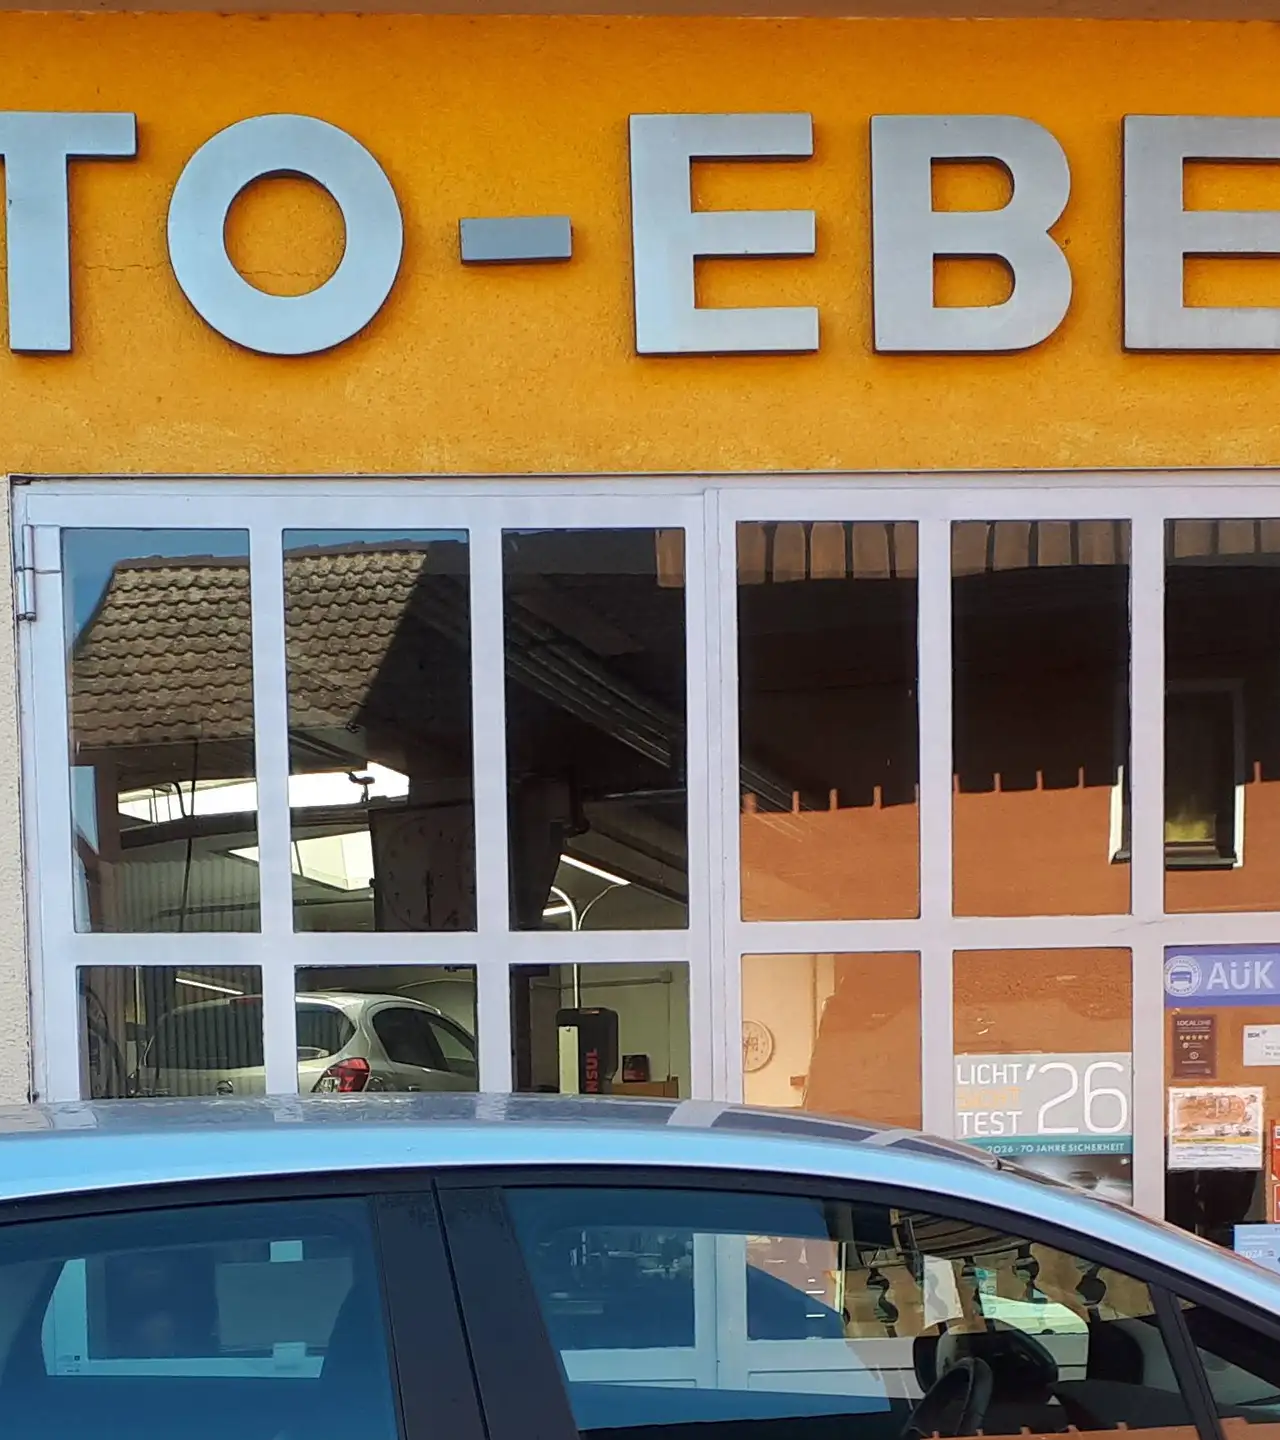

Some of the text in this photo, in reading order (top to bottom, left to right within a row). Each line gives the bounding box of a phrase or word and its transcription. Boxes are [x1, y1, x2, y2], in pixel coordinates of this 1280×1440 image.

[1206, 961, 1275, 990] AÜK
[956, 1063, 1022, 1085] LICHT
[958, 1111, 1023, 1135] TEST
[1021, 1145, 1034, 1153] 70
[1035, 1144, 1066, 1152] JAHRE
[1069, 1143, 1125, 1152] SICHERHEIT
